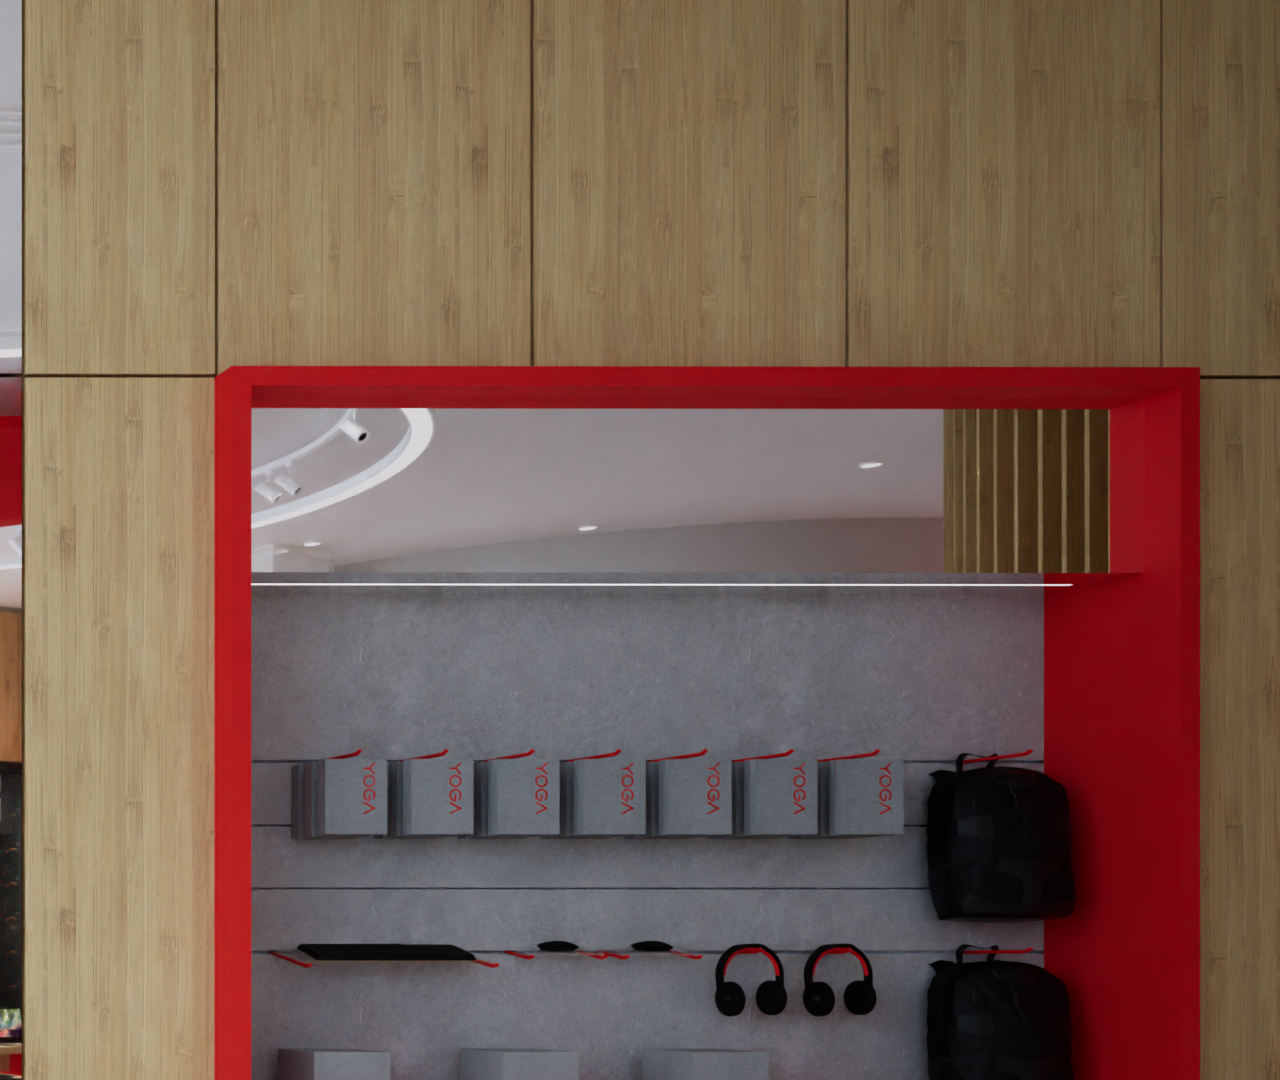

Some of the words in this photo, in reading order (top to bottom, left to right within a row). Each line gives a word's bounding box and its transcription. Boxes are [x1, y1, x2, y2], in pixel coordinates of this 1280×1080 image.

[362, 761, 377, 815] YOGA
[448, 761, 463, 815] YOGA
[534, 761, 549, 815] YOGA
[620, 761, 635, 815] YOGA
[706, 761, 721, 815] YOGA
[792, 761, 807, 815] YOGA
[878, 761, 893, 815] YOGA
